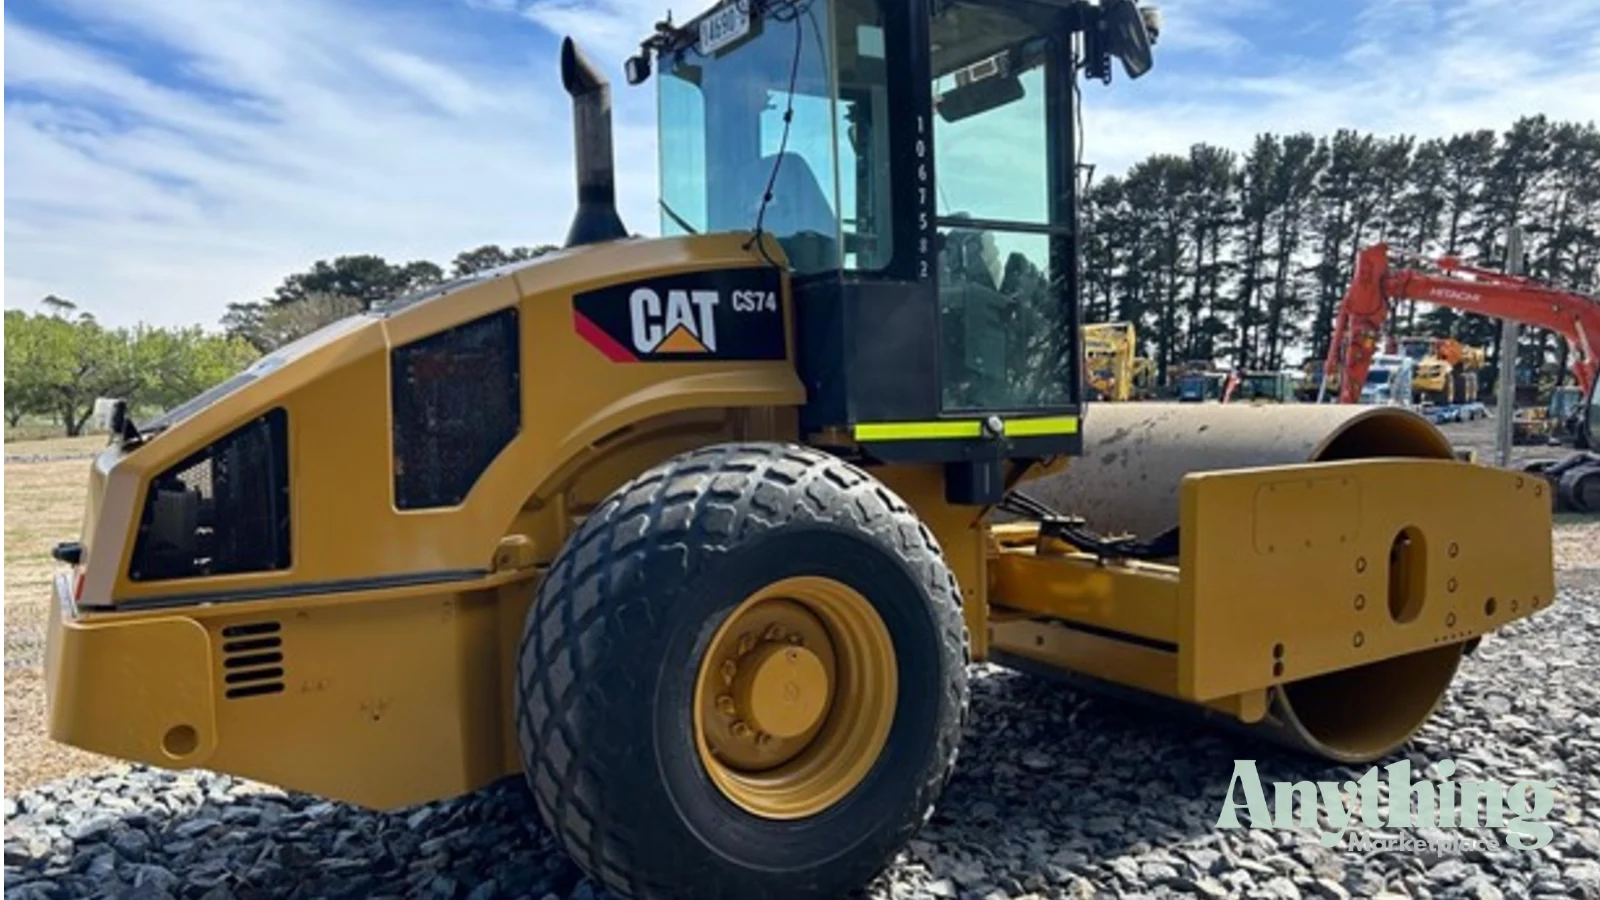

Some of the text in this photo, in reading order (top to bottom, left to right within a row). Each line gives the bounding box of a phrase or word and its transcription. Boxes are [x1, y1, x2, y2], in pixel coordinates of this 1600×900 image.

[915, 115, 928, 278] 1067582
[629, 287, 776, 353] CAT CS74
[1430, 287, 1480, 302] HITACHI
